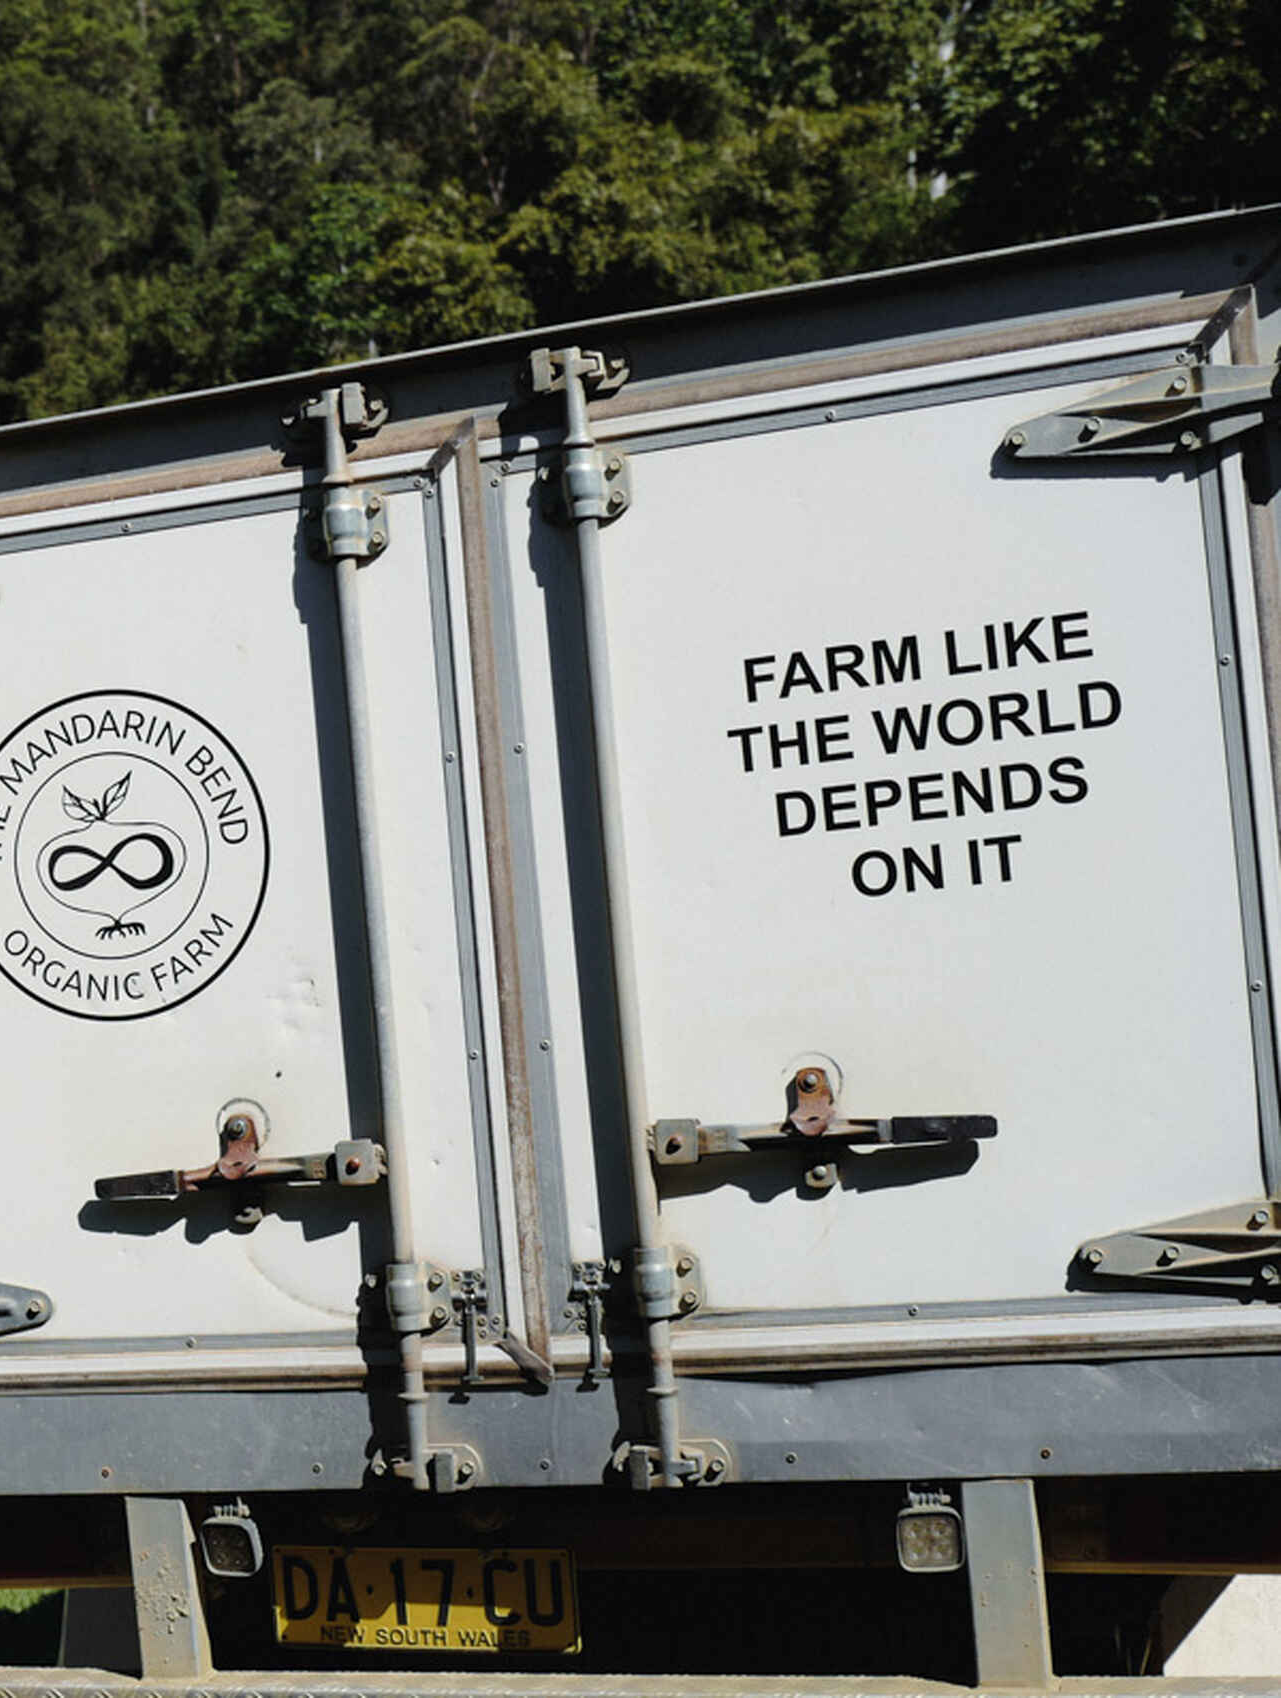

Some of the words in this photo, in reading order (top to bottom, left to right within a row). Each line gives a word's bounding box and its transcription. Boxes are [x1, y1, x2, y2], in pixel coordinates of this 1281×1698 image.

[743, 634, 922, 703] FARM
[944, 610, 1094, 676] LIKE
[726, 714, 855, 773] THE
[871, 680, 1123, 755] WORLD
[184, 745, 249, 845] BEND
[775, 756, 1089, 837] DEPENDS
[851, 843, 945, 897] ON
[967, 833, 1023, 886] IT
[4, 929, 145, 1001] ORGANIC
[150, 912, 234, 993] FARM
[320, 1625, 365, 1643] NEW
[375, 1628, 447, 1646] SOUTH
[457, 1629, 531, 1647] WALES
